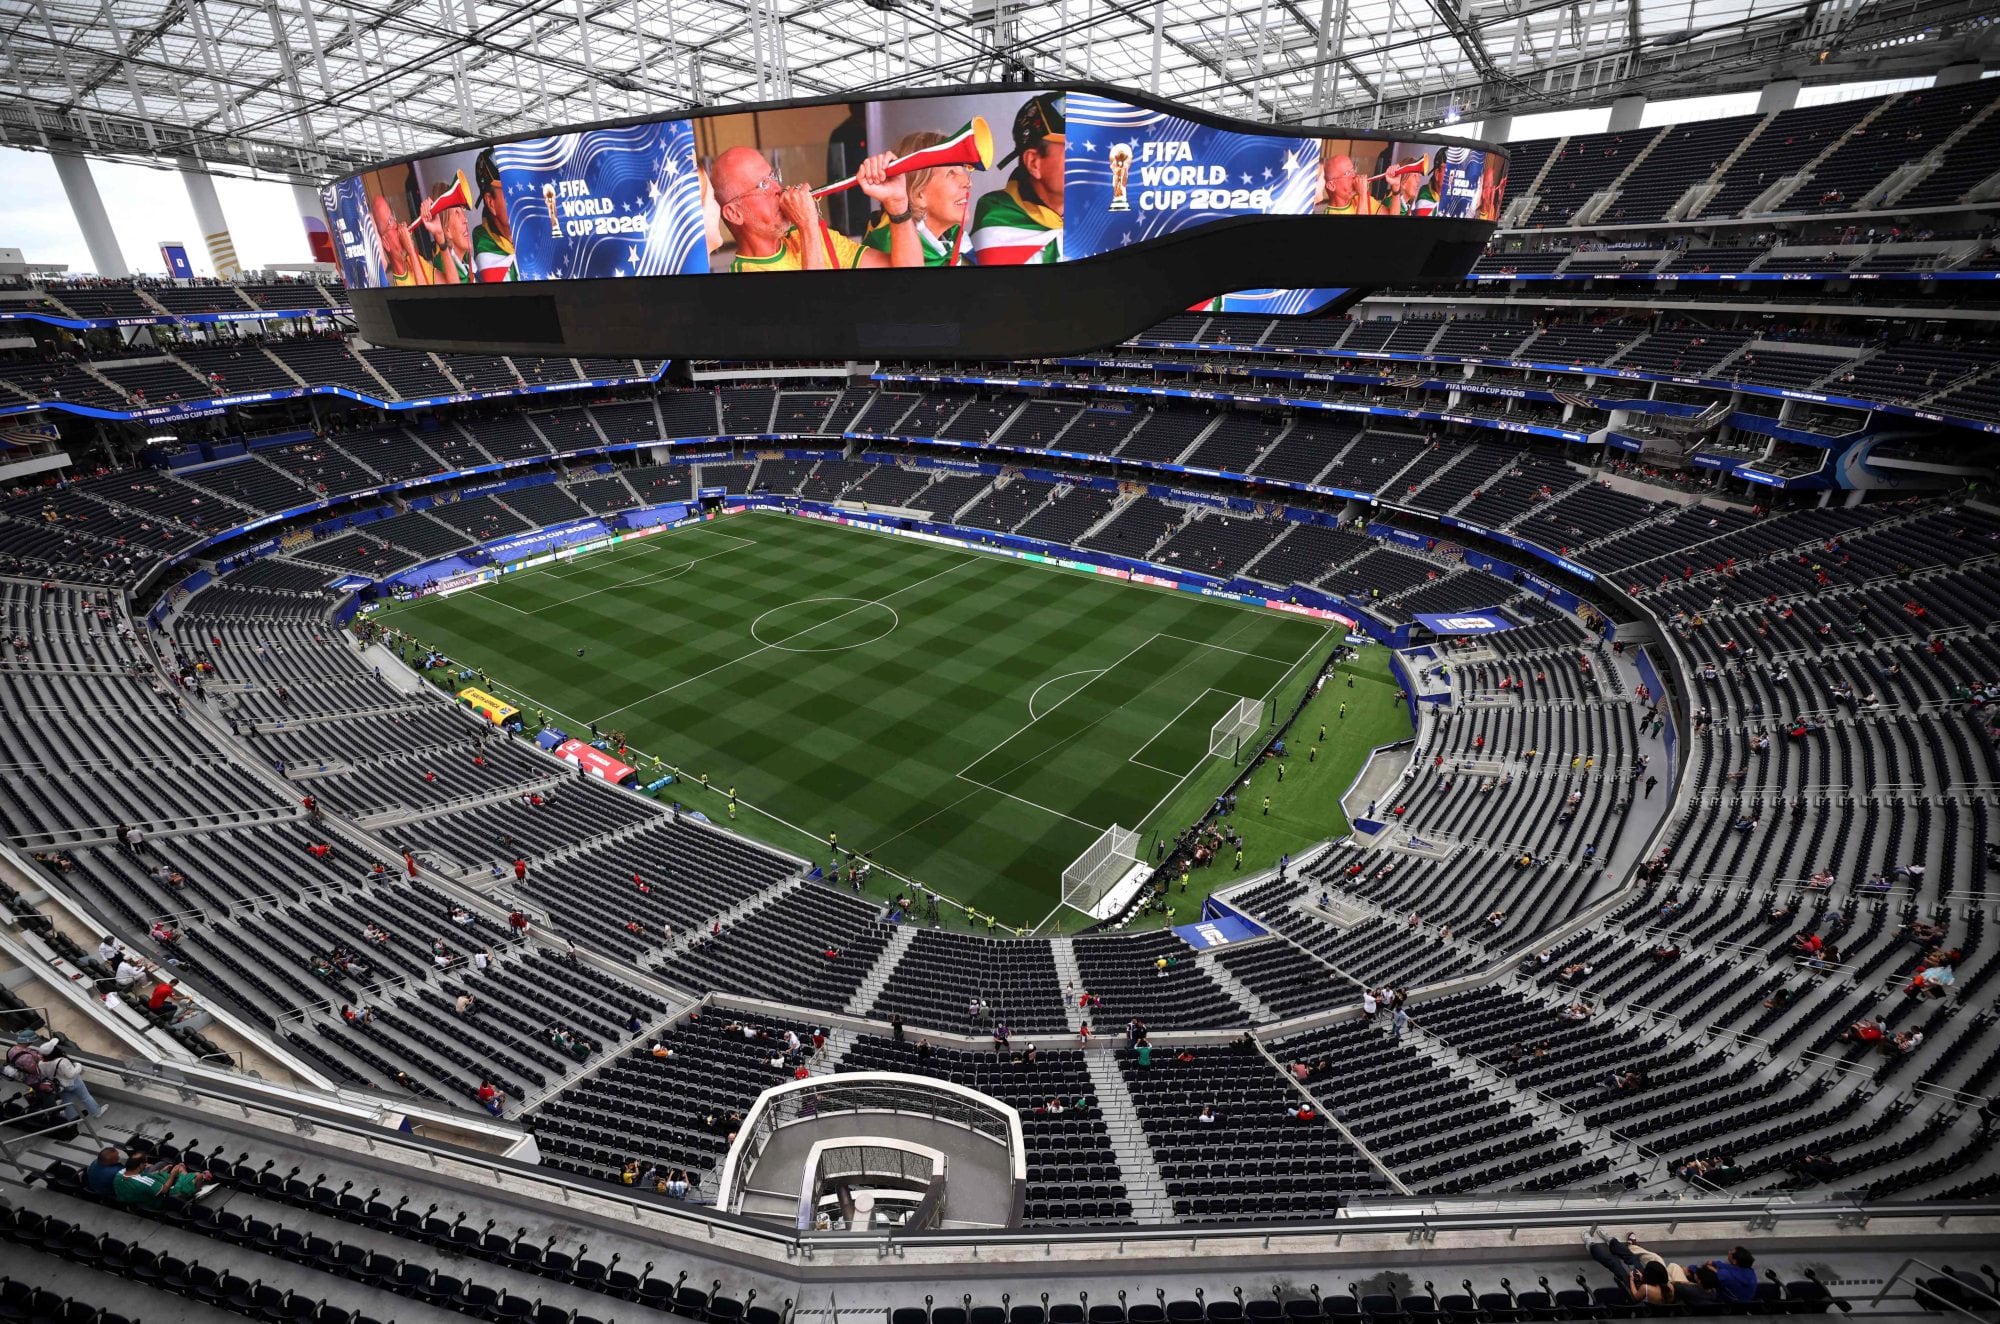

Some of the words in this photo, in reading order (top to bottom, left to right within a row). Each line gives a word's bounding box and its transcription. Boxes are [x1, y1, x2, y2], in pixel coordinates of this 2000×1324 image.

[1143, 142, 1193, 162] FIFA
[1141, 166, 1226, 186] WORLD
[559, 180, 590, 198] FIFA
[562, 198, 613, 217] WORLD
[1140, 190, 1187, 210] CUP
[1189, 189, 1266, 209] 2026
[567, 220, 593, 236] CUP
[595, 215, 646, 234] 2026
[1461, 385, 1484, 393] WORLD
[1485, 387, 1500, 395] CUP
[1500, 389, 1526, 398] 2026
[165, 413, 190, 422] WORLD
[190, 410, 203, 418] CUP
[203, 407, 225, 416] 2026
[478, 482, 506, 491] ANGELES
[1182, 490, 1199, 498] WORLD
[490, 544, 512, 552] FIFA
[510, 535, 546, 547] WORLD
[546, 530, 564, 538] CUP
[565, 522, 598, 534] 2026
[1213, 591, 1240, 600] HYUNDAI
[1280, 604, 1309, 614] Lenovo
